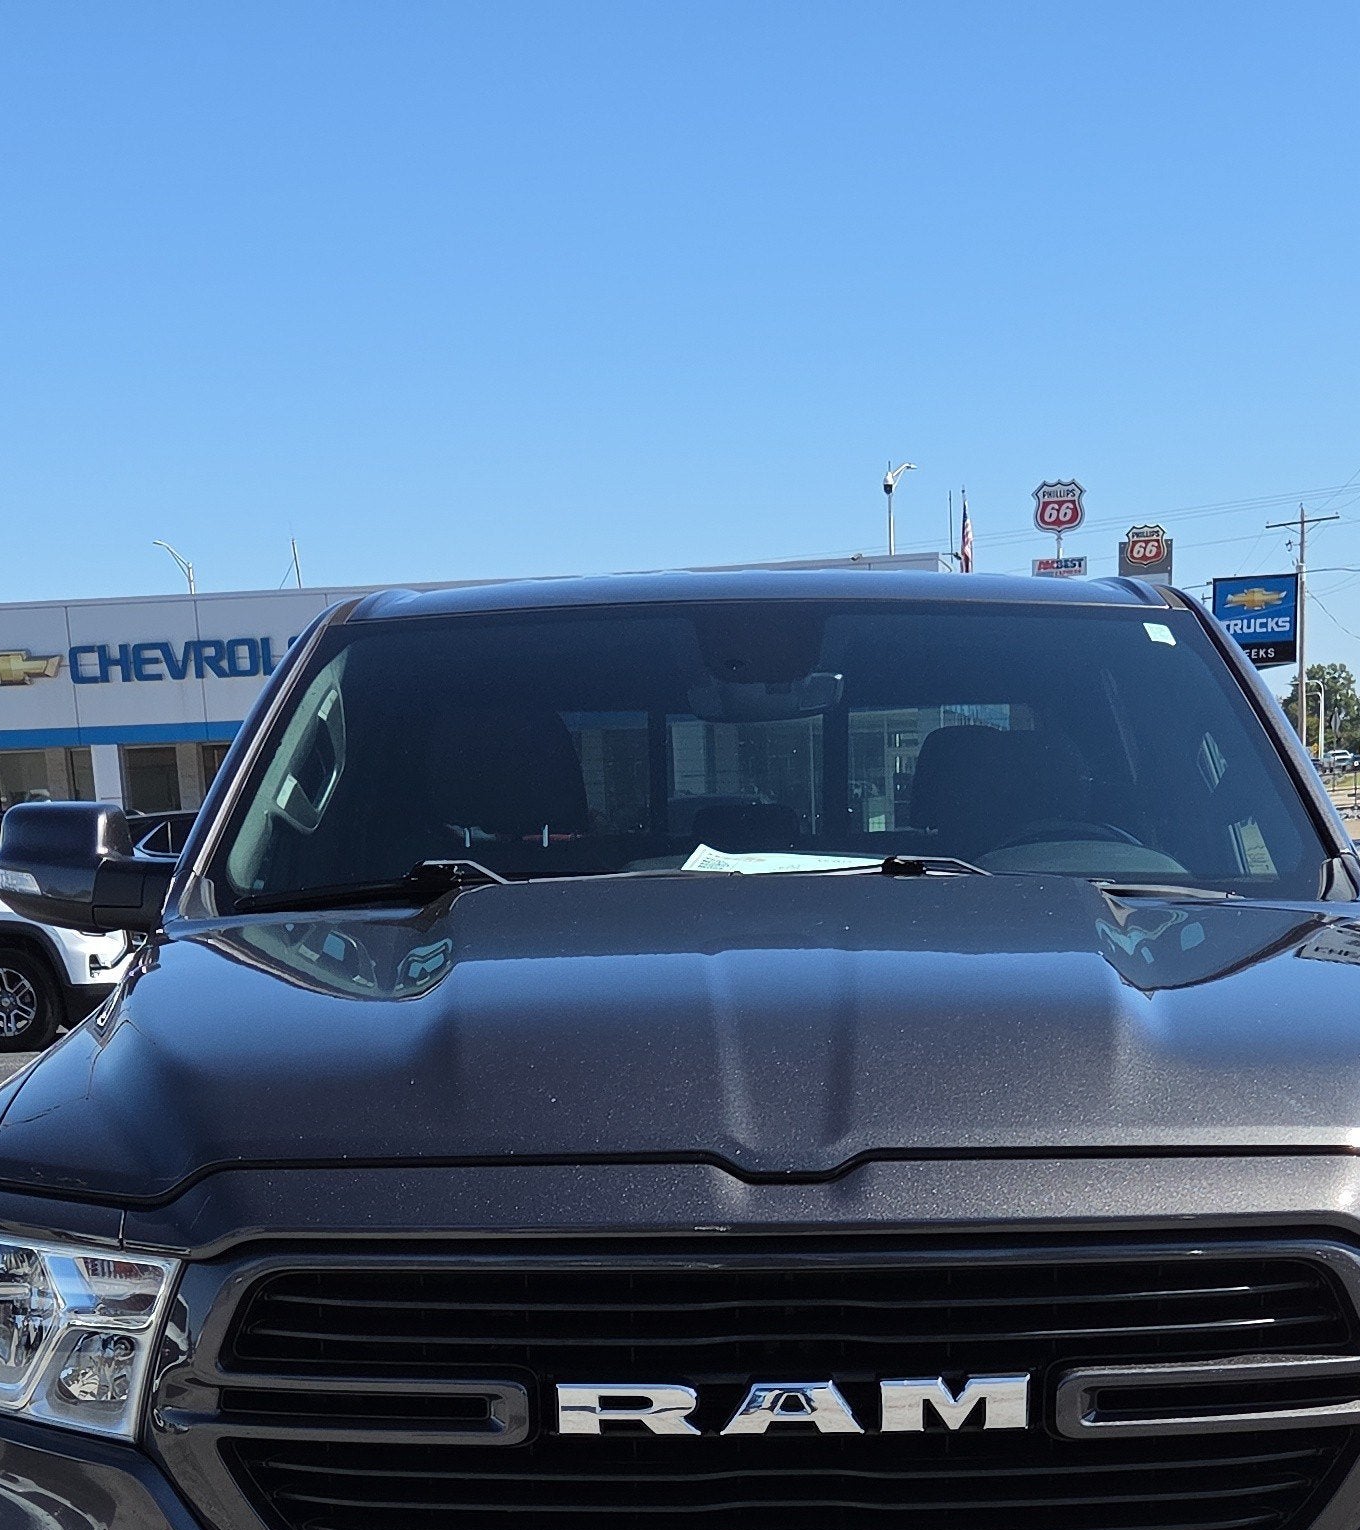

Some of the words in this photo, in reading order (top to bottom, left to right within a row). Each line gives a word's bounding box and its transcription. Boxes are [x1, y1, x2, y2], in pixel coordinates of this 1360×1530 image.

[1042, 488, 1076, 499] PHILLIPS
[1044, 502, 1074, 523] 66
[1131, 529, 1160, 539] PHILLIPS
[1132, 541, 1159, 558] 66
[68, 635, 302, 685] CHEVROL
[555, 1372, 1031, 1436] RAM
